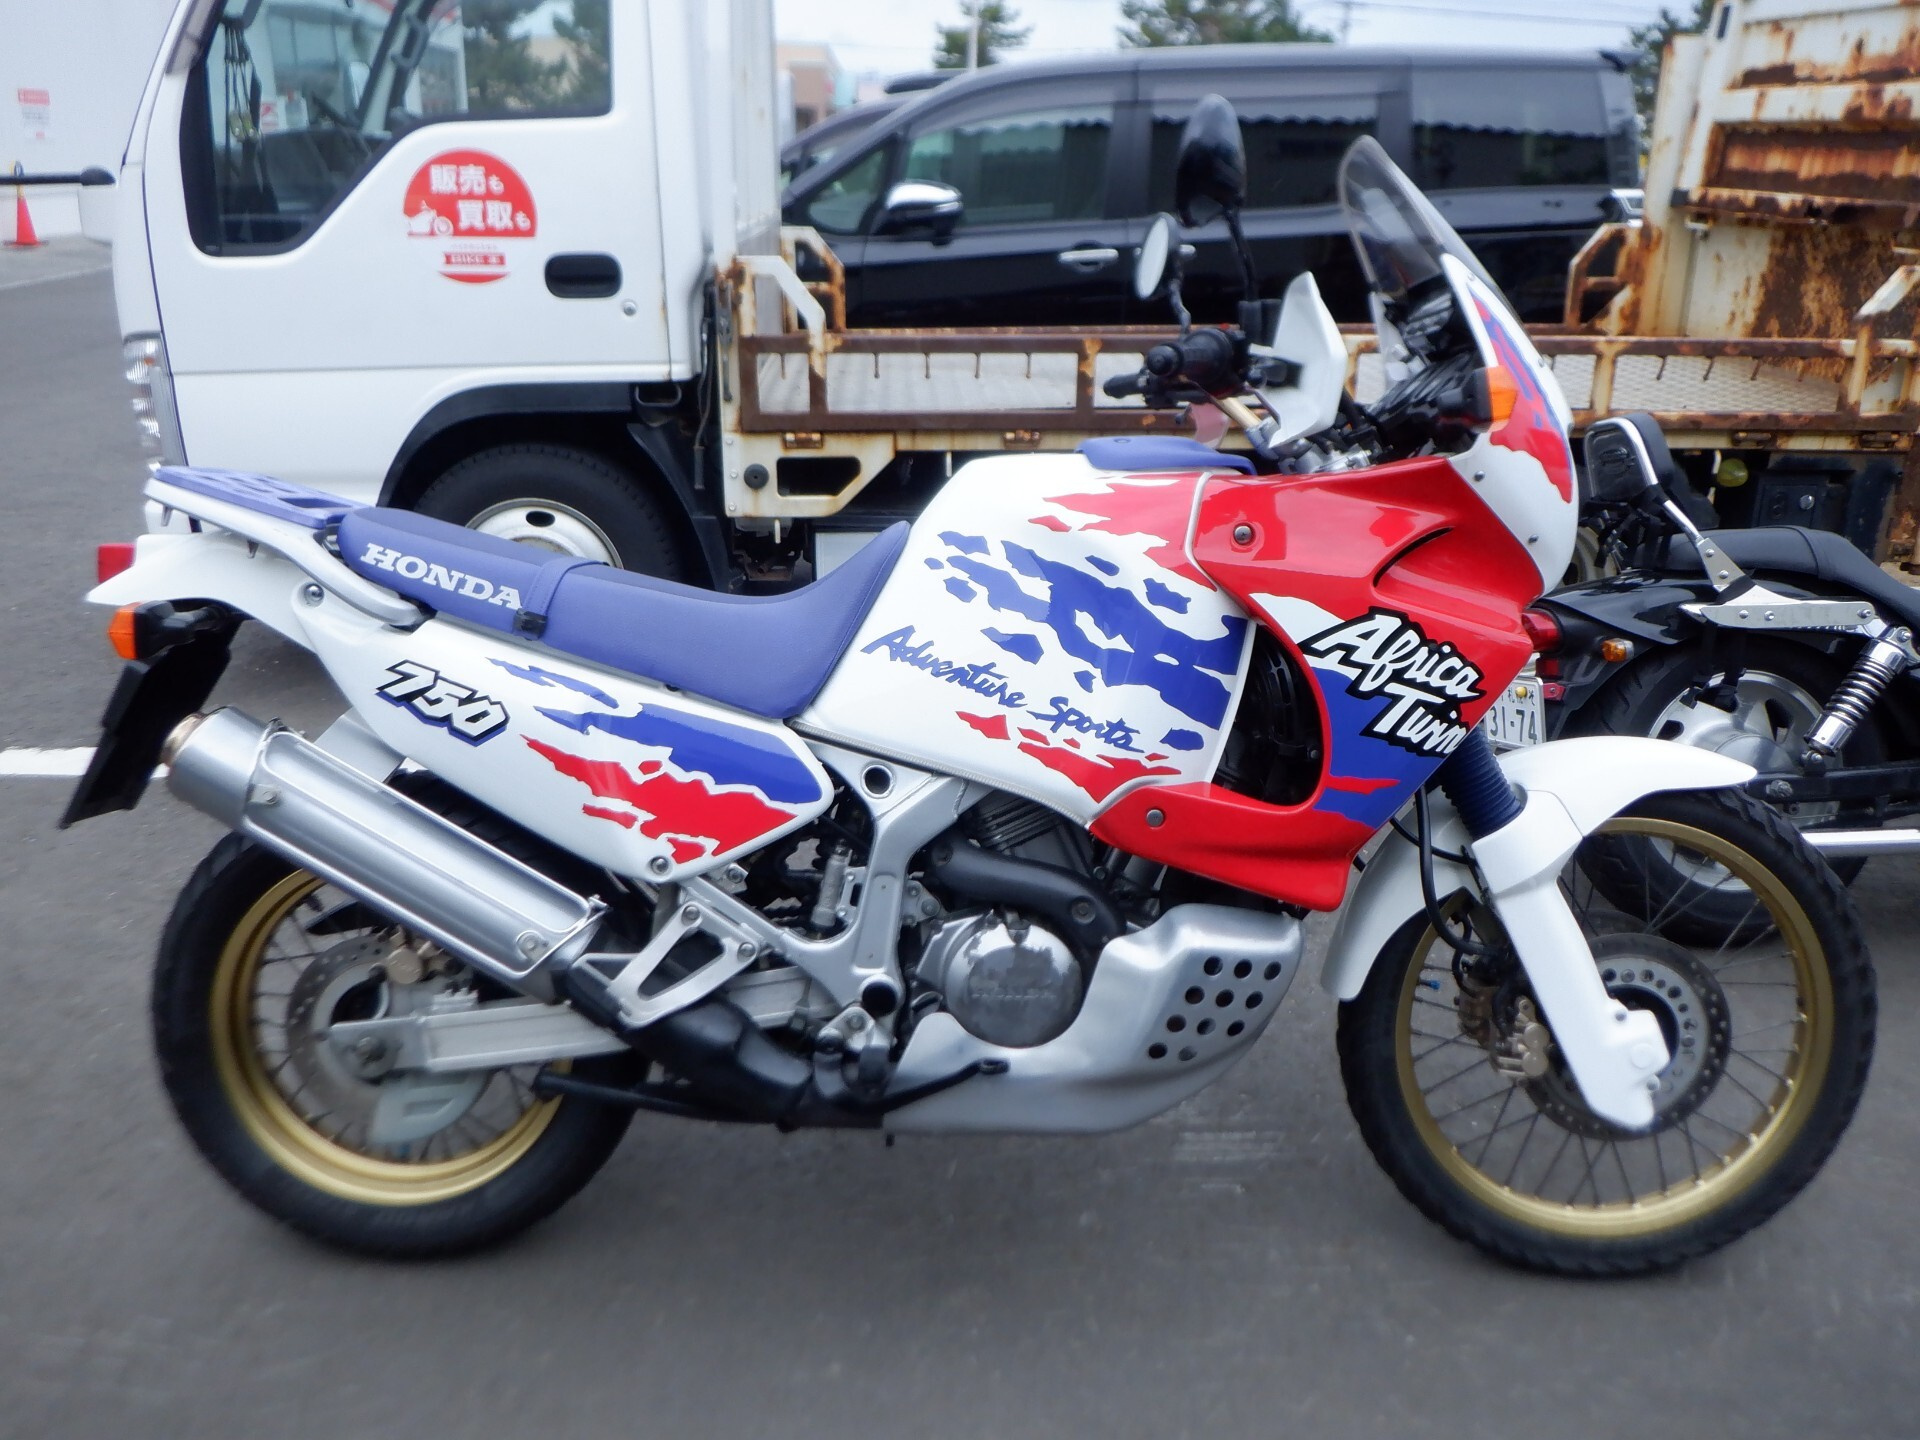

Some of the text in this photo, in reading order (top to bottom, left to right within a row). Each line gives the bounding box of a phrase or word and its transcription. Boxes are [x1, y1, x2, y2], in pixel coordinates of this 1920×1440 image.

[430, 163, 505, 196] 販売も
[457, 199, 532, 231] 買取も
[360, 542, 522, 610] HONDA
[860, 625, 1145, 753] Adventure Sports
[1308, 611, 1482, 699] Africa
[376, 659, 510, 746] 750
[1371, 682, 1468, 755] Twin
[1490, 705, 1538, 744] 31-74
